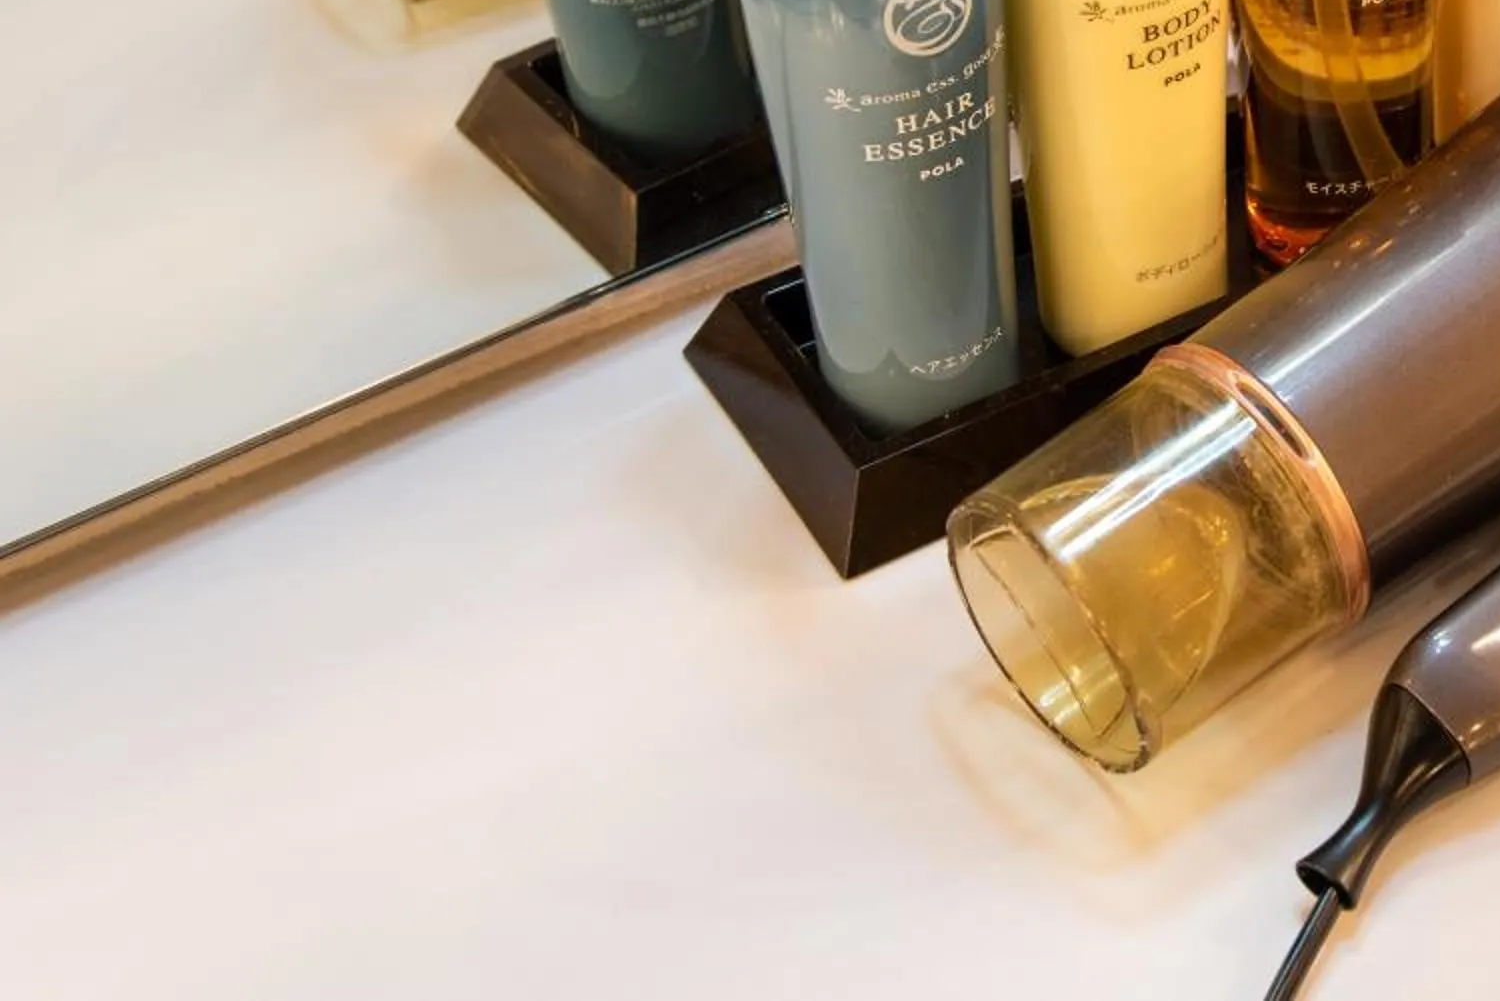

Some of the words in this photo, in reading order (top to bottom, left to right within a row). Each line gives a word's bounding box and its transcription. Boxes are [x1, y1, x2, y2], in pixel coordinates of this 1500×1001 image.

[1126, 9, 1221, 70] LOTION
[1164, 62, 1201, 87] POLA
[860, 89, 921, 106] aroma
[896, 92, 975, 135] HAIR
[863, 95, 997, 162] ESSENCE
[919, 156, 965, 181] POLA
